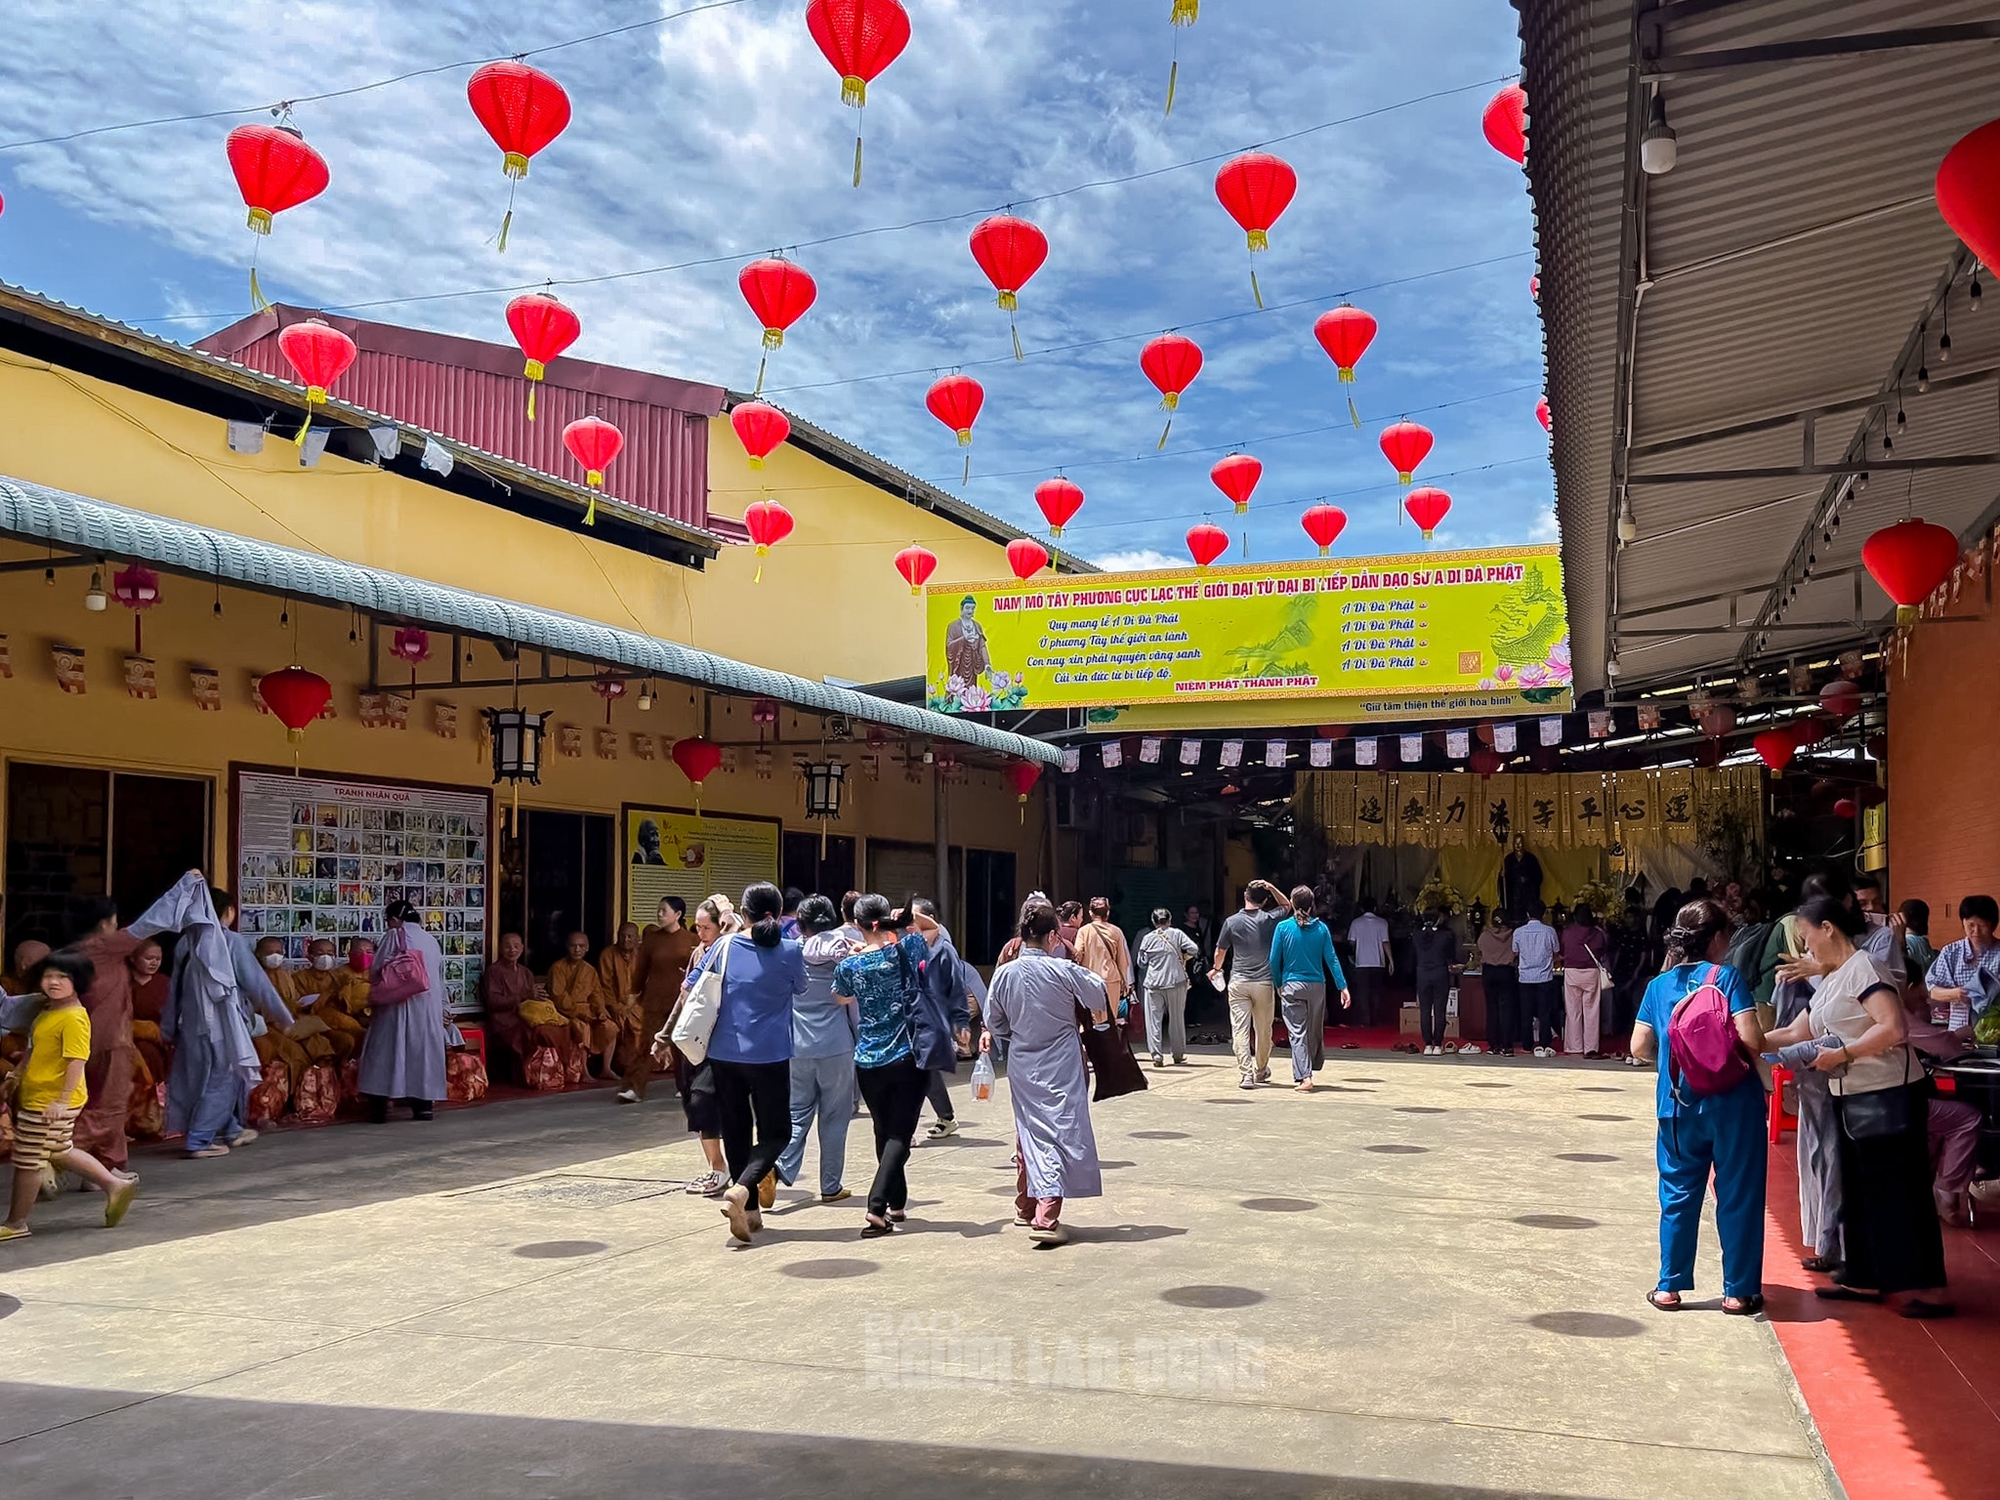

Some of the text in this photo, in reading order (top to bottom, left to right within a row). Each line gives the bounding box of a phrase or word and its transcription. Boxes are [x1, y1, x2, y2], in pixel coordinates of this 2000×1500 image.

[994, 597, 1021, 611] NAM
[1025, 592, 1043, 609] MÔ
[1047, 592, 1070, 607] TÂY
[1073, 590, 1121, 605] PHƯƠNG
[1126, 588, 1148, 605] CỰC
[1151, 587, 1173, 603] LẠC
[1177, 580, 1200, 599] THẾ
[1204, 581, 1229, 598] GIỚI
[1232, 582, 1253, 598] ĐẠI
[1257, 577, 1274, 594] TỪ
[1278, 579, 1299, 596] ĐẠI
[1303, 578, 1315, 591] BI
[1352, 569, 1379, 588] DẪN
[1383, 573, 1409, 589] ĐẠO
[1413, 571, 1432, 585] SƯ
[1435, 571, 1443, 584] A
[1448, 569, 1461, 583] DI
[1465, 565, 1483, 582] ĐÀ
[1487, 563, 1523, 583] PHẬT
[1342, 600, 1414, 614] A Di Đà Phật
[1048, 619, 1067, 631] Quy
[1071, 618, 1098, 631] mạng
[1112, 616, 1120, 627] A
[1123, 615, 1134, 625] Di
[1138, 615, 1152, 624] Đà
[1155, 613, 1179, 624] Phật
[1342, 619, 1414, 633] A Di Đà Phật
[1049, 638, 1086, 650] phương
[1089, 635, 1107, 647] Tây
[1110, 632, 1127, 645] thế
[1127, 632, 1146, 646] giới
[1165, 631, 1188, 641] lành
[1342, 638, 1414, 652] A Di Đà Phật
[1027, 648, 1201, 667] Con nay xin phát nguyện vãng sanh
[1342, 656, 1414, 670] A Di Đà Phật
[1054, 672, 1070, 683] Cúi
[1073, 671, 1088, 682] xin
[1124, 669, 1133, 679] bi
[1136, 668, 1154, 681] tiếp
[1175, 681, 1206, 692] NIỆM
[1209, 679, 1240, 690] PHẬT
[1286, 675, 1318, 687] PHẬT
[1384, 701, 1401, 711] tâm
[1404, 699, 1428, 711] thiện
[1431, 698, 1448, 708] thế
[1449, 697, 1467, 709] giới
[333, 787, 364, 797] TRANH
[366, 790, 390, 799] NHÂN
